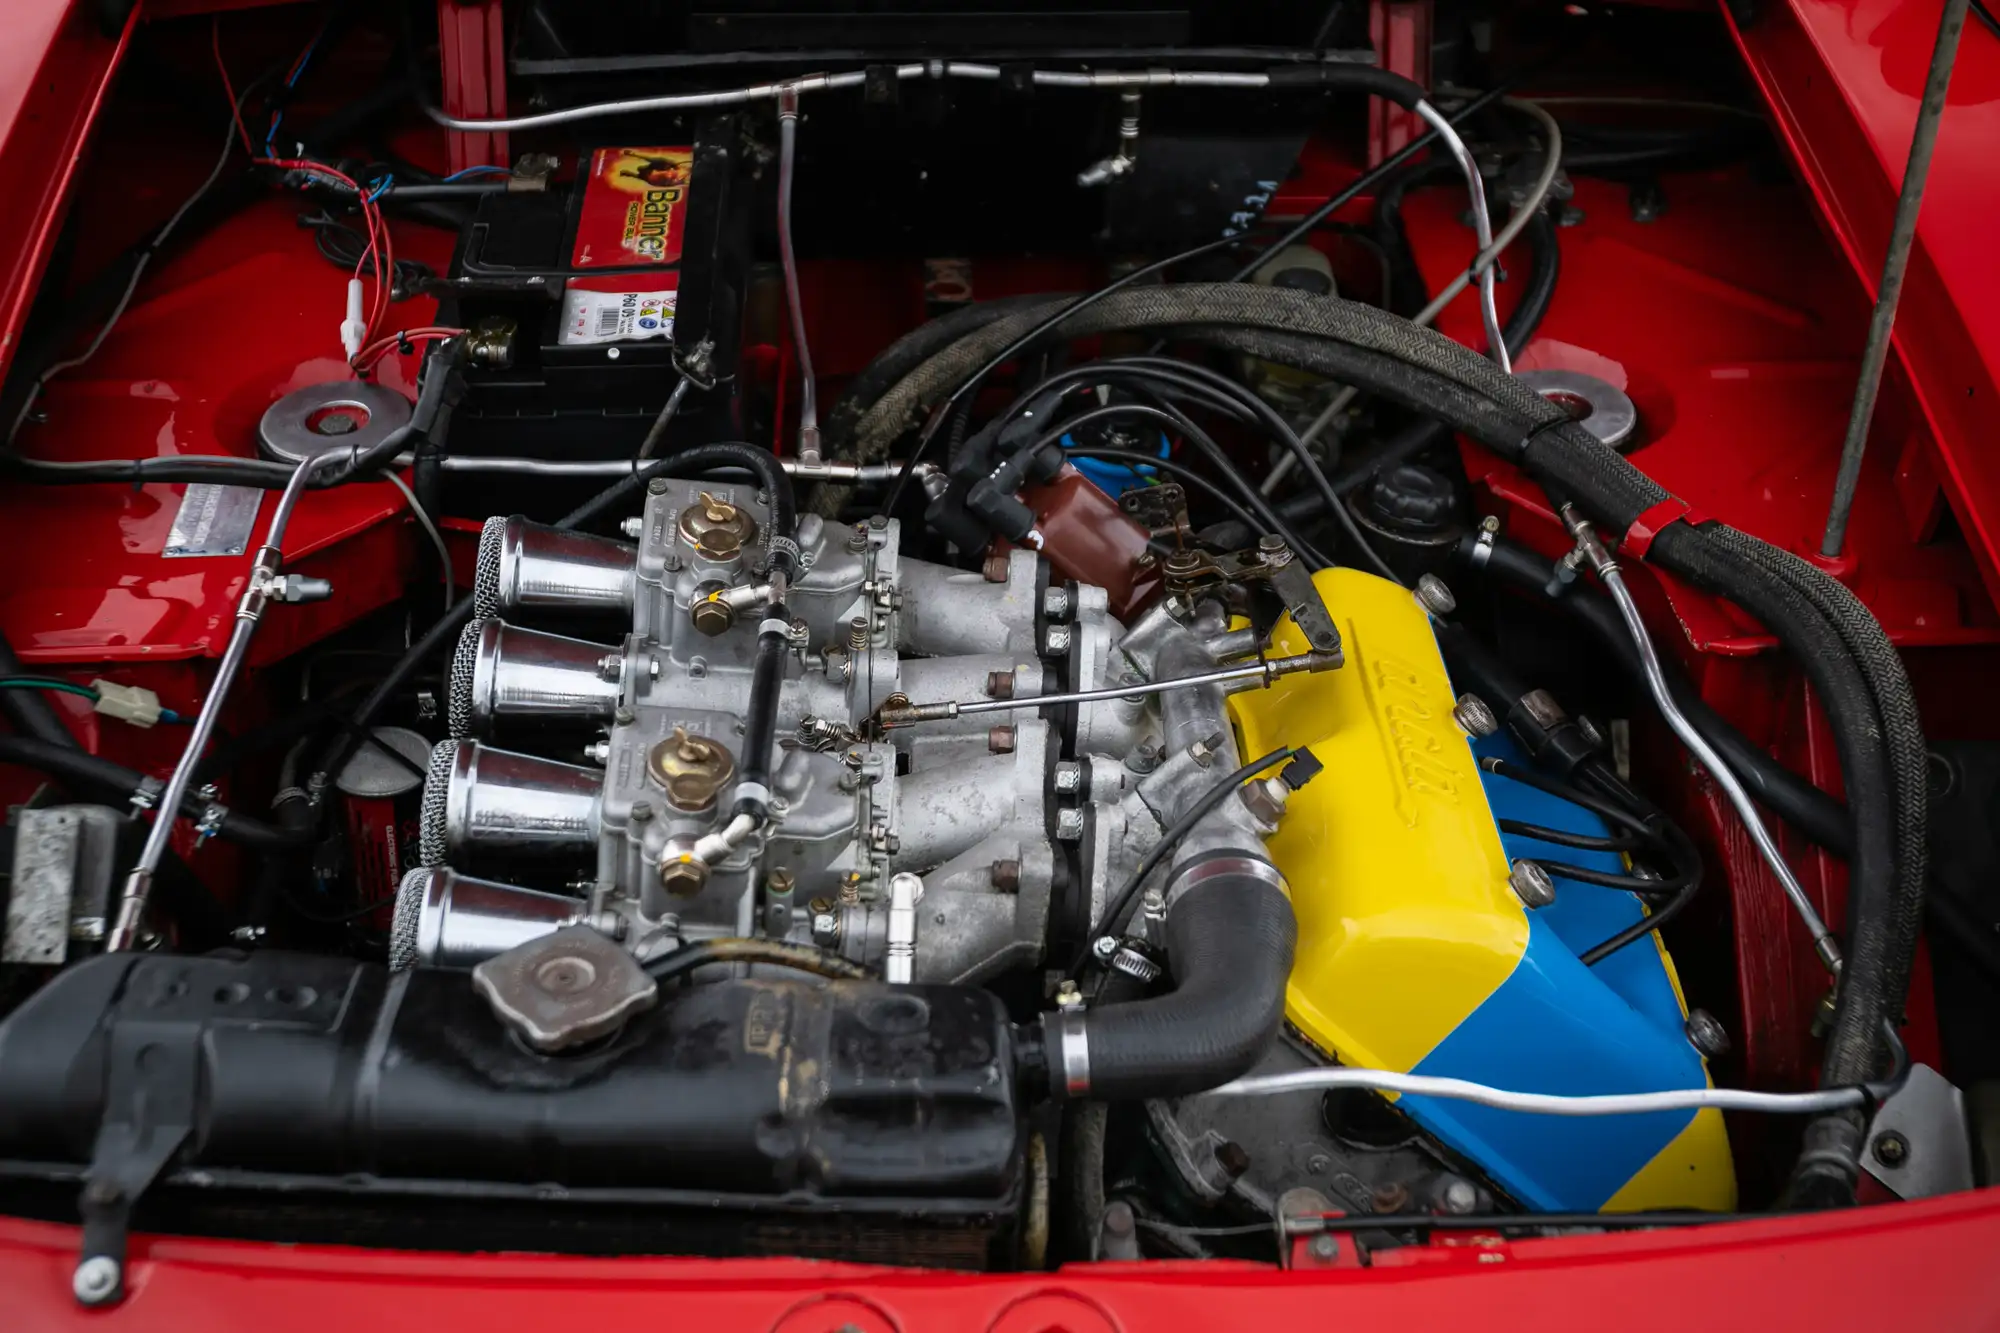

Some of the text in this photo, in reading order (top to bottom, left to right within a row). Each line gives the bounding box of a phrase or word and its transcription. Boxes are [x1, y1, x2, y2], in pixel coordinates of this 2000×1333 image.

[628, 202, 639, 226] POWER
[638, 189, 681, 260] Banner
[622, 294, 638, 307] P60
[621, 308, 636, 318] 09
